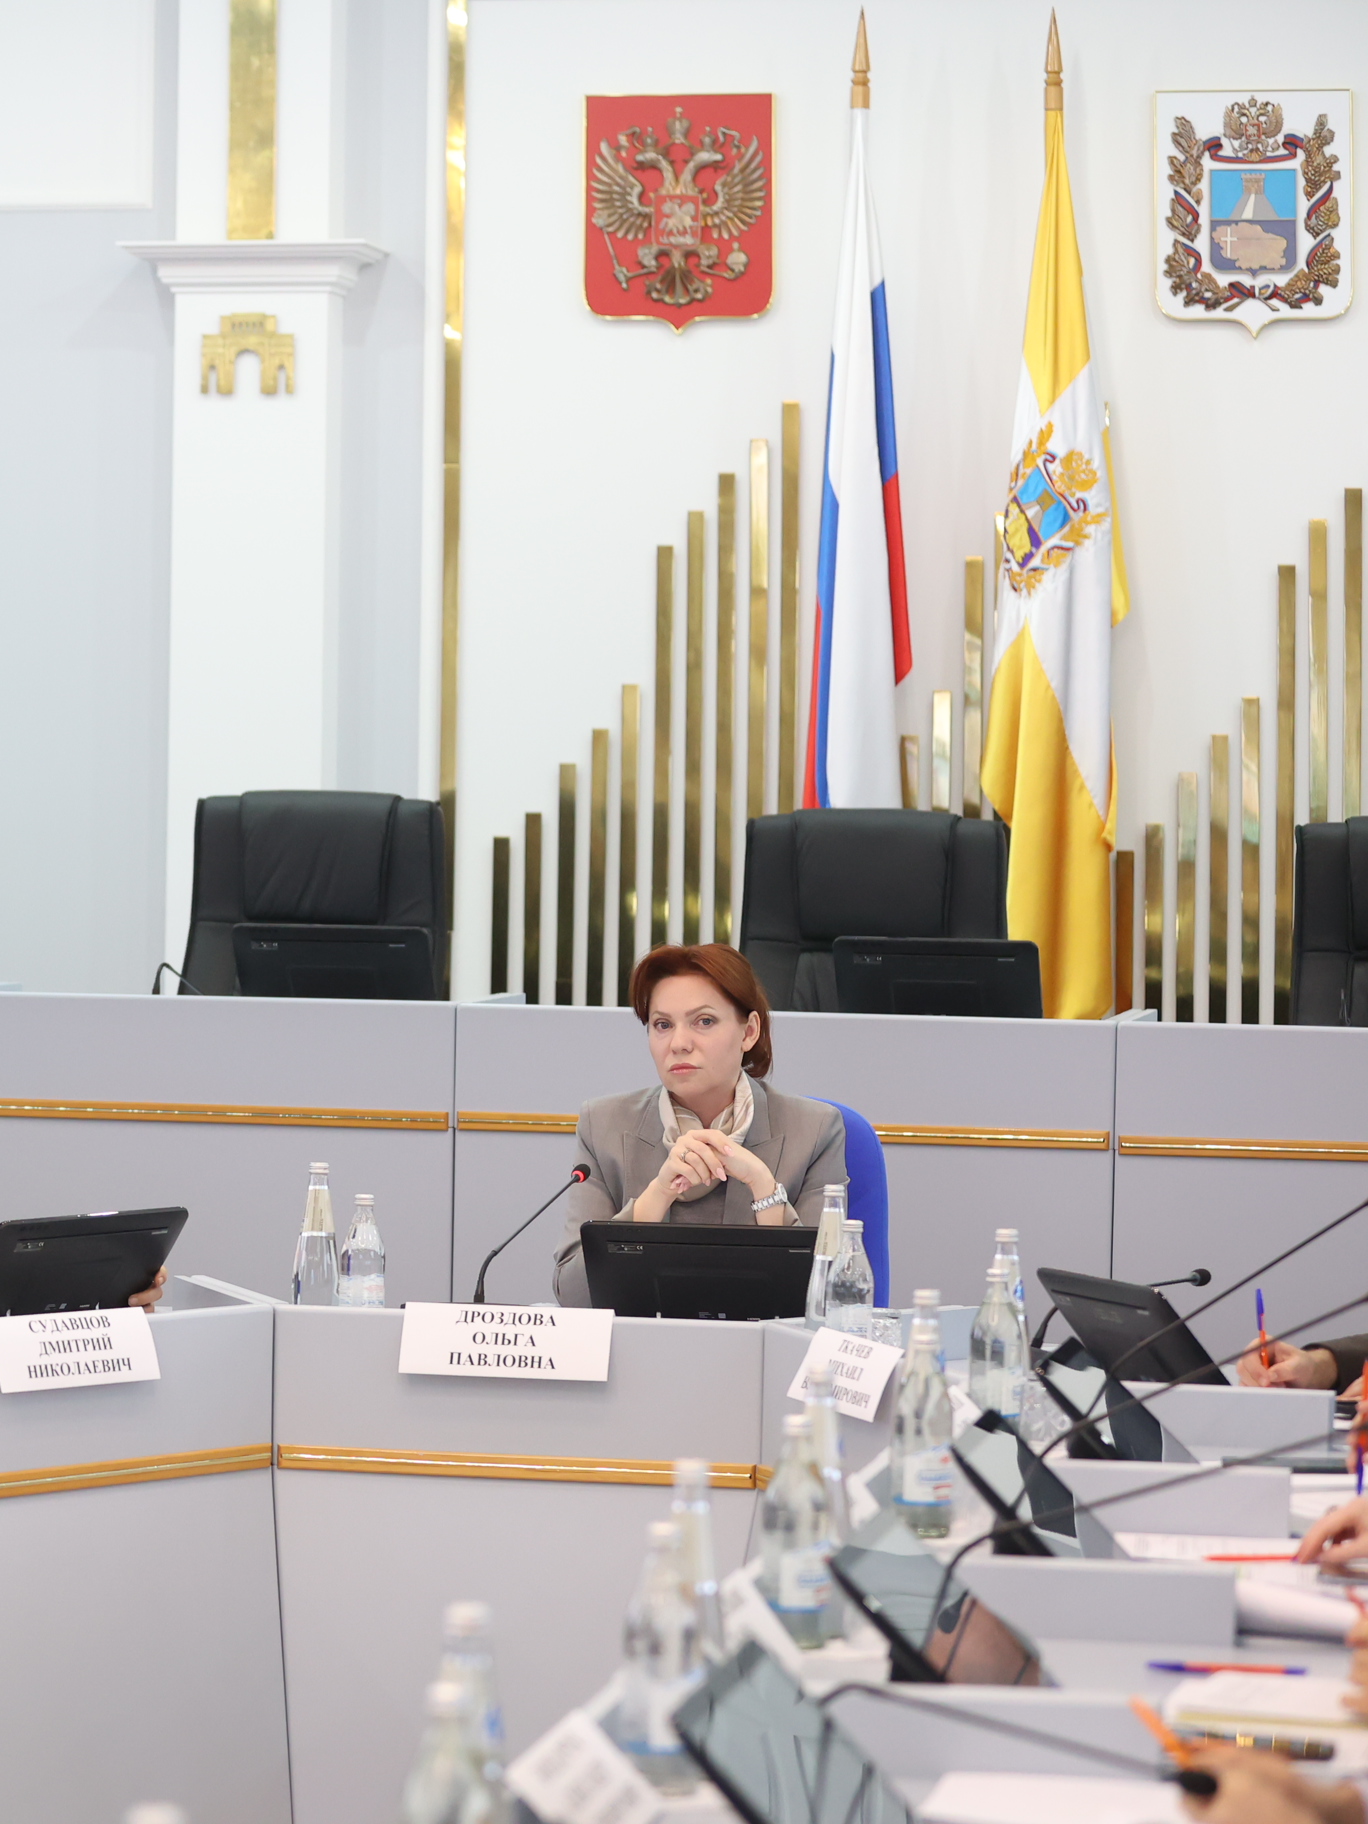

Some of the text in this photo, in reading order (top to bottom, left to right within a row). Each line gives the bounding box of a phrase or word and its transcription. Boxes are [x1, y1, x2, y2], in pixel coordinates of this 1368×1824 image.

[28, 1315, 111, 1333] СУДАВЦОВ
[455, 1309, 557, 1327] ДРОЗДОВА
[39, 1334, 113, 1357] ДМИТРИЙ
[472, 1331, 536, 1347] ОЛЬГА
[838, 1339, 873, 1359] ТКАЧЕВ
[27, 1357, 132, 1379] НИКОЛАЕВИЧ
[448, 1351, 556, 1370] ПАВЛОВНА
